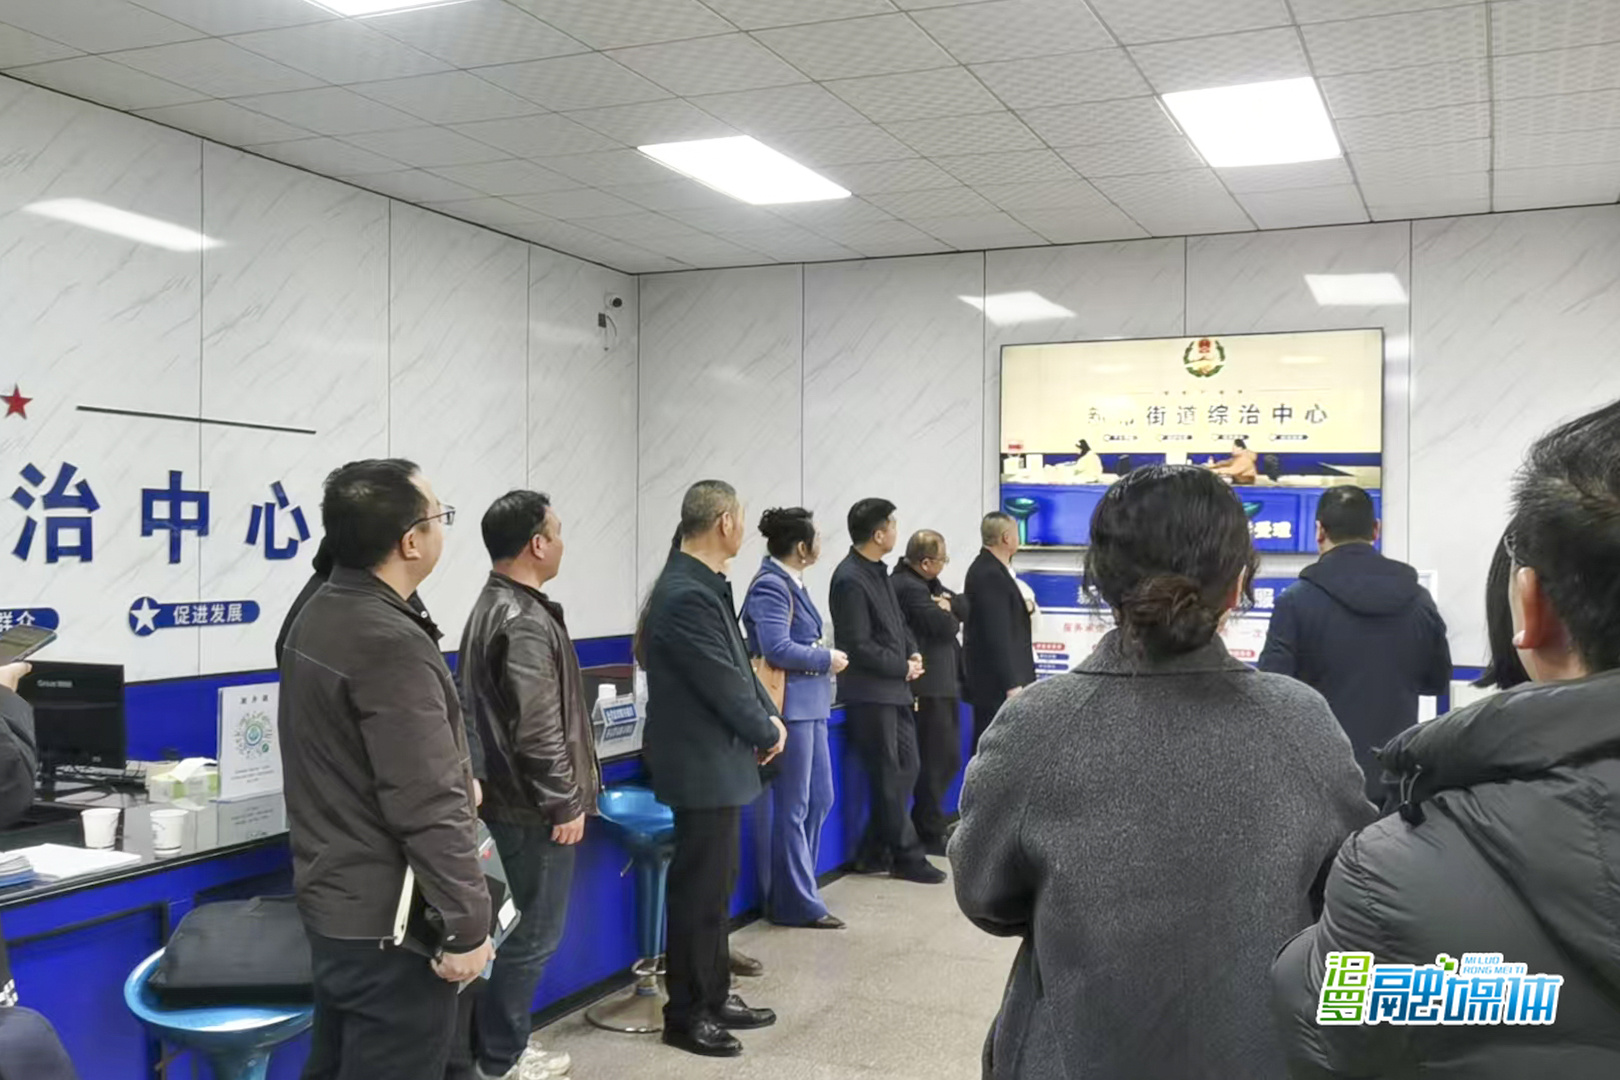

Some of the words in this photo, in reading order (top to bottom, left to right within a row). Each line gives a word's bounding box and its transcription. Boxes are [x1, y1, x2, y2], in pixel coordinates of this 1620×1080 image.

[10, 461, 311, 565] 治中心
[172, 602, 244, 625] 促进发展
